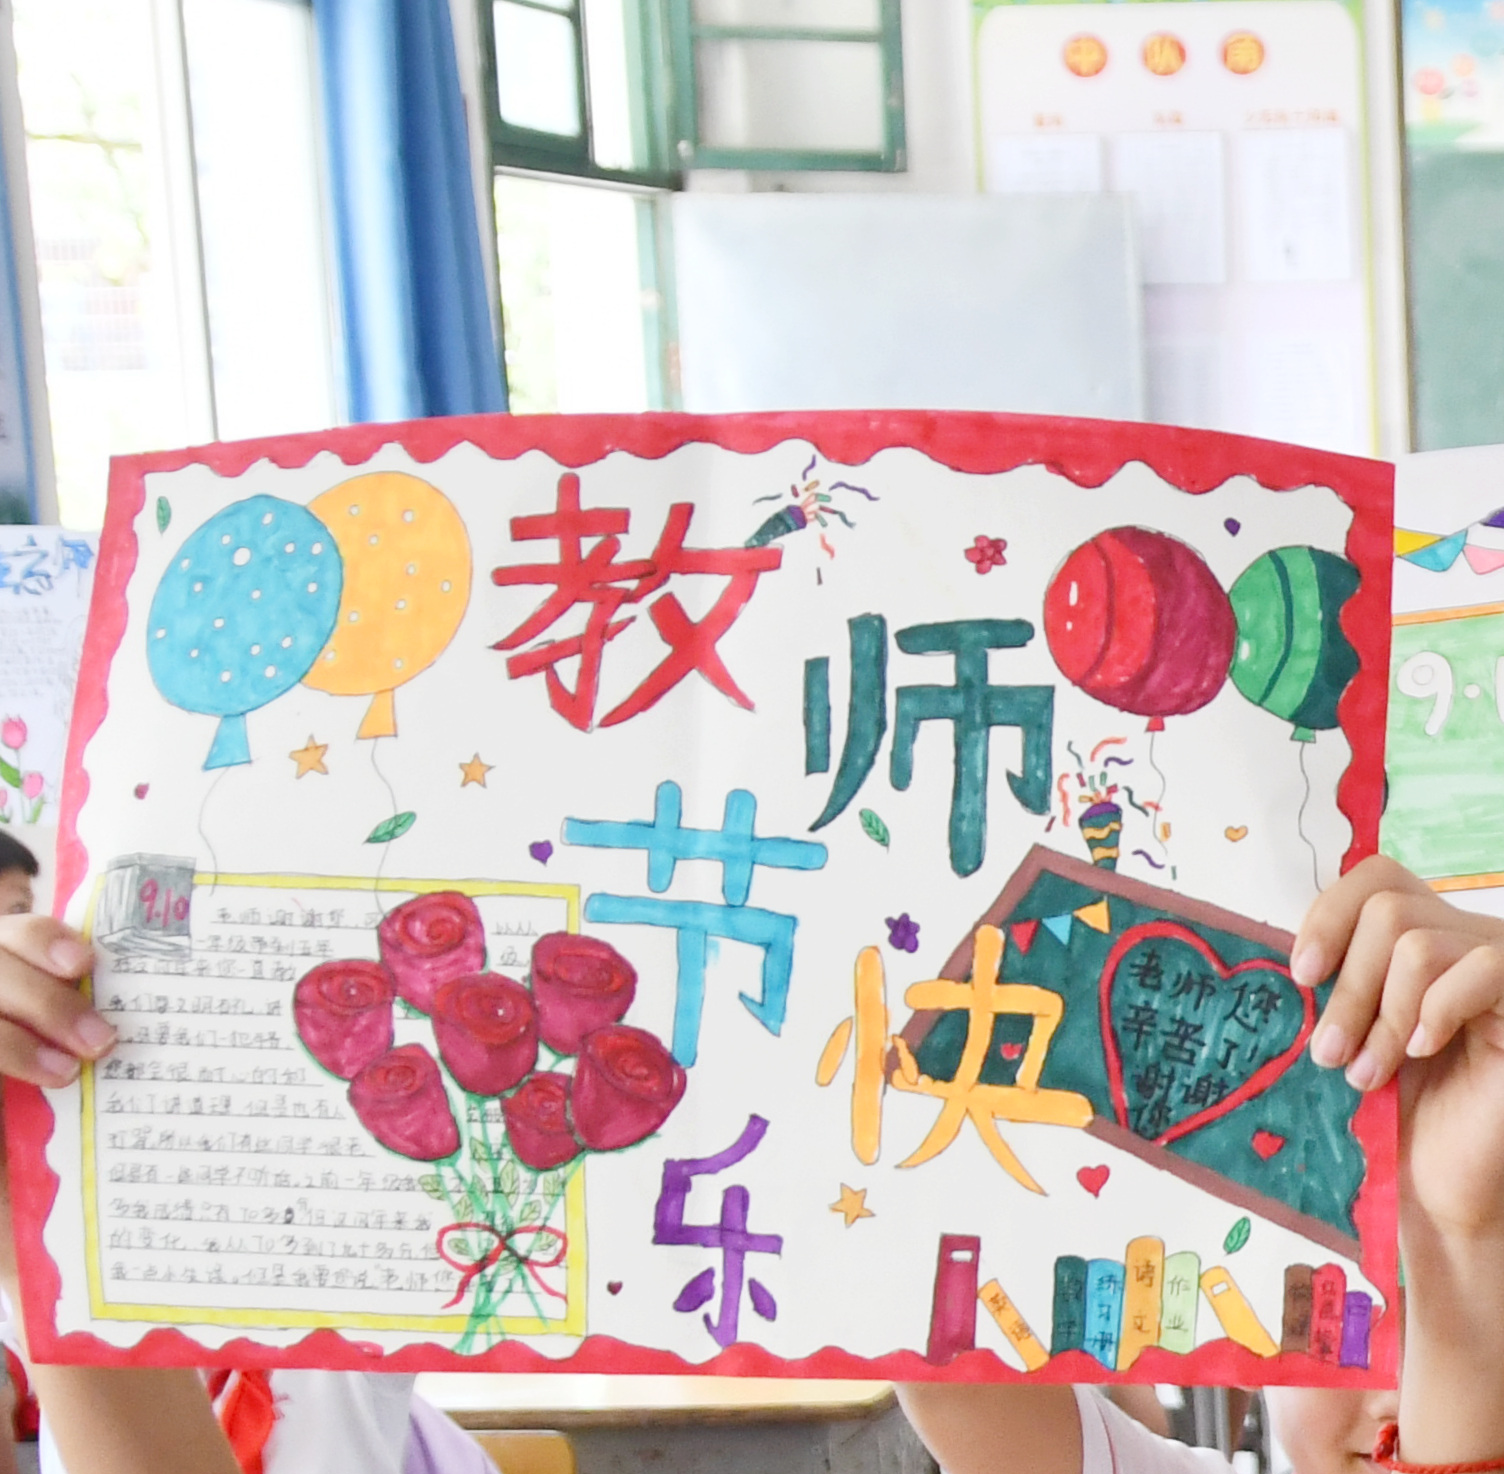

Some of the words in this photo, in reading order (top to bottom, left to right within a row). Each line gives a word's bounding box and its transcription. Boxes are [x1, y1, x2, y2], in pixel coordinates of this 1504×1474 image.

[139, 876, 189, 923] 9.10
[1128, 947, 1282, 1034] 老师您
[1092, 1273, 1122, 1352] 练习册
[1130, 1260, 1158, 1336] 语文
[1165, 1273, 1192, 1334] 作业
